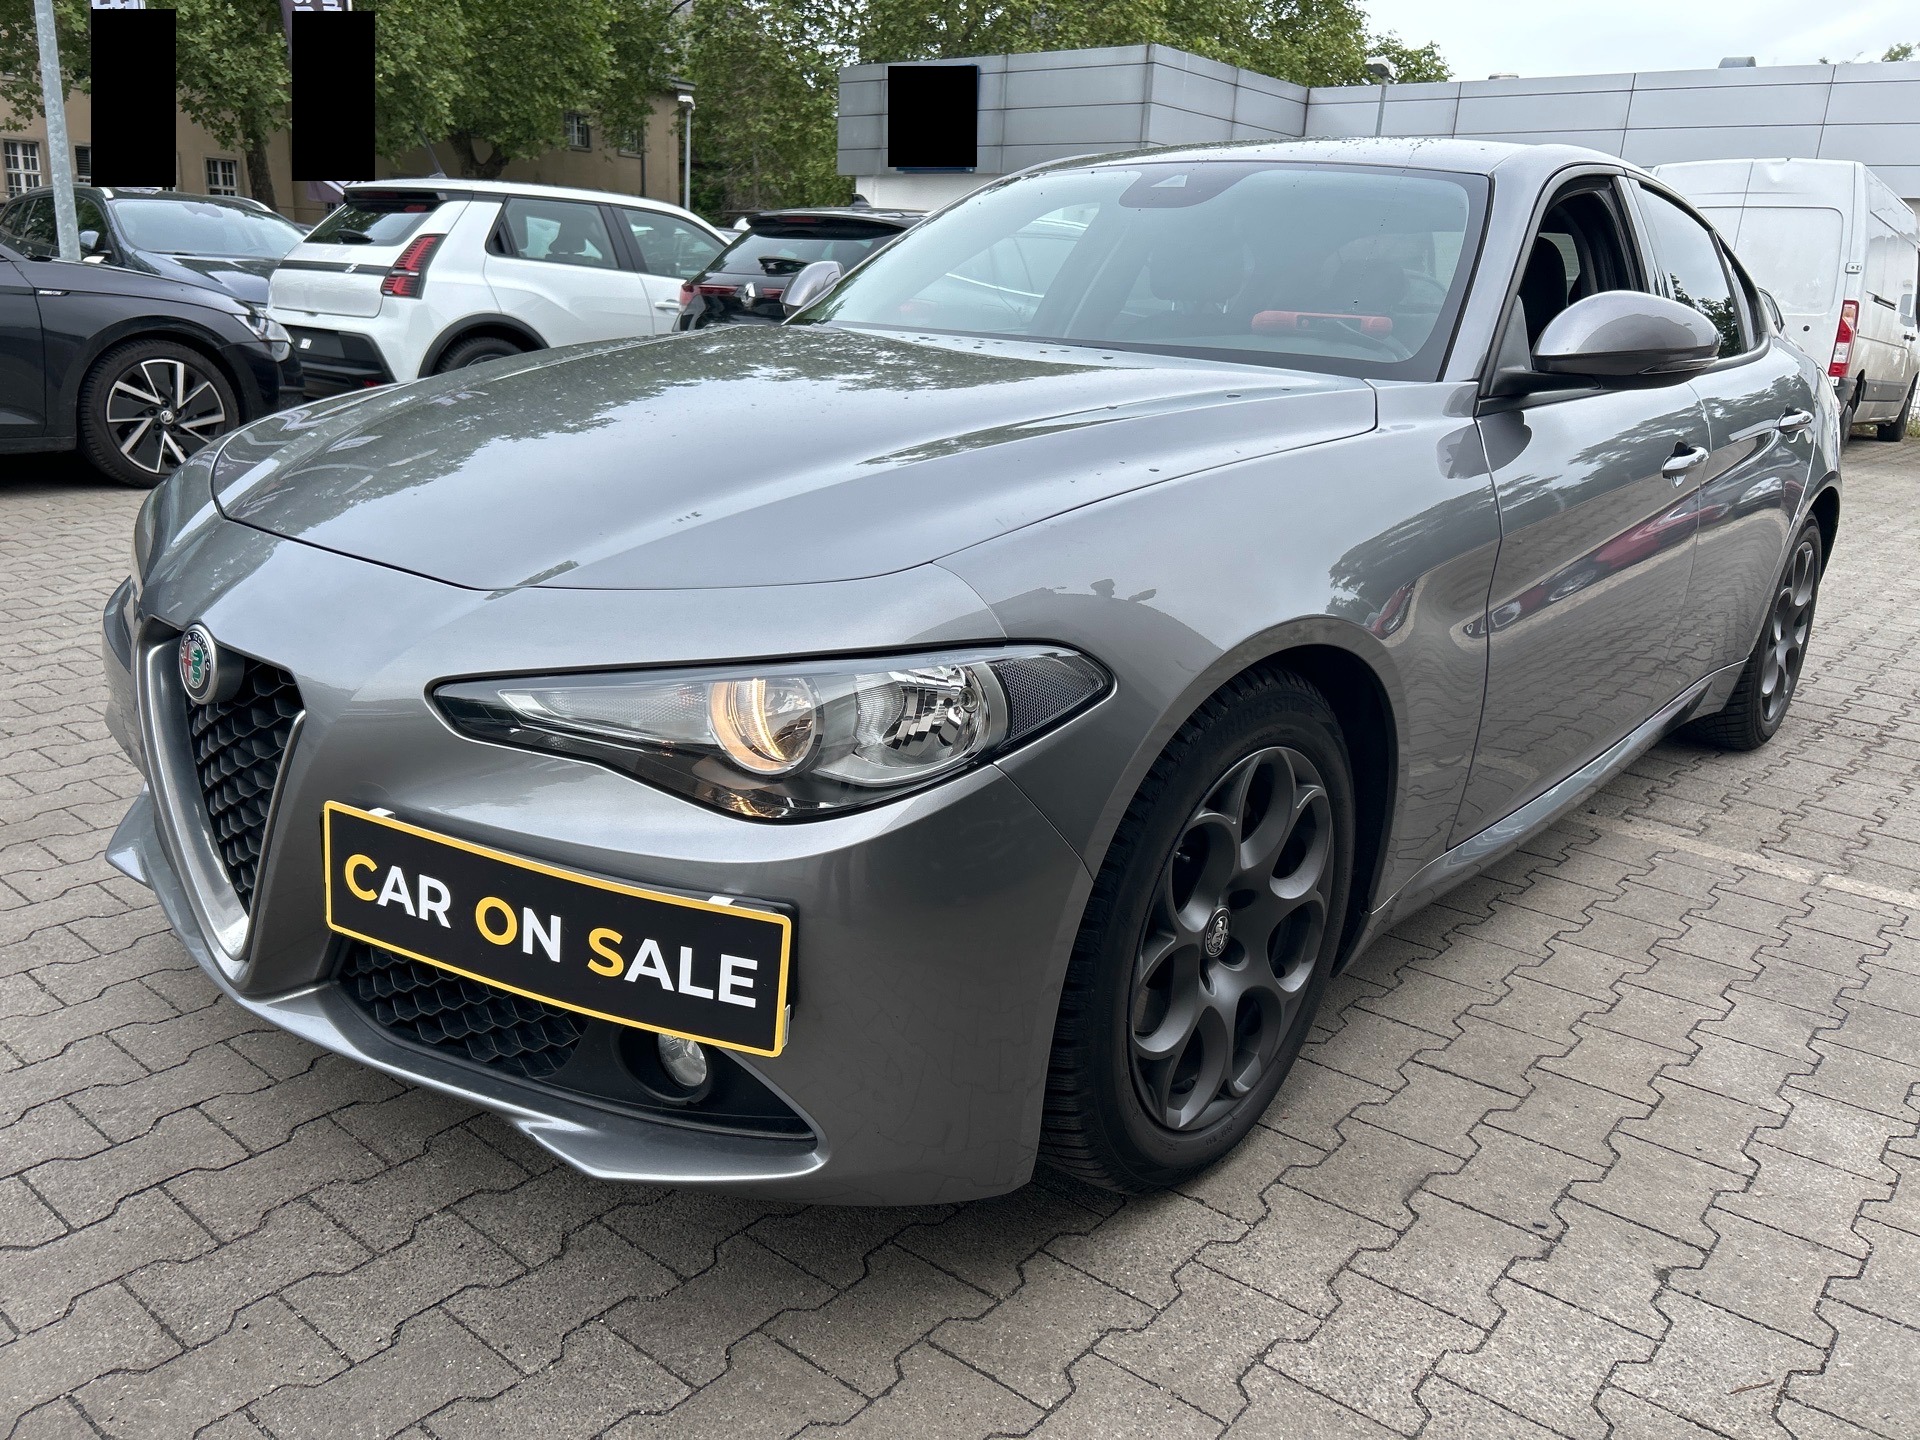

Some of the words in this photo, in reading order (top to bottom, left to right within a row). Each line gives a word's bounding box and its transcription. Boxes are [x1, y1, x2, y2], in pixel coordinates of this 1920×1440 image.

[344, 853, 452, 929] CAR
[475, 896, 562, 963] ON
[587, 927, 758, 1009] SALE
